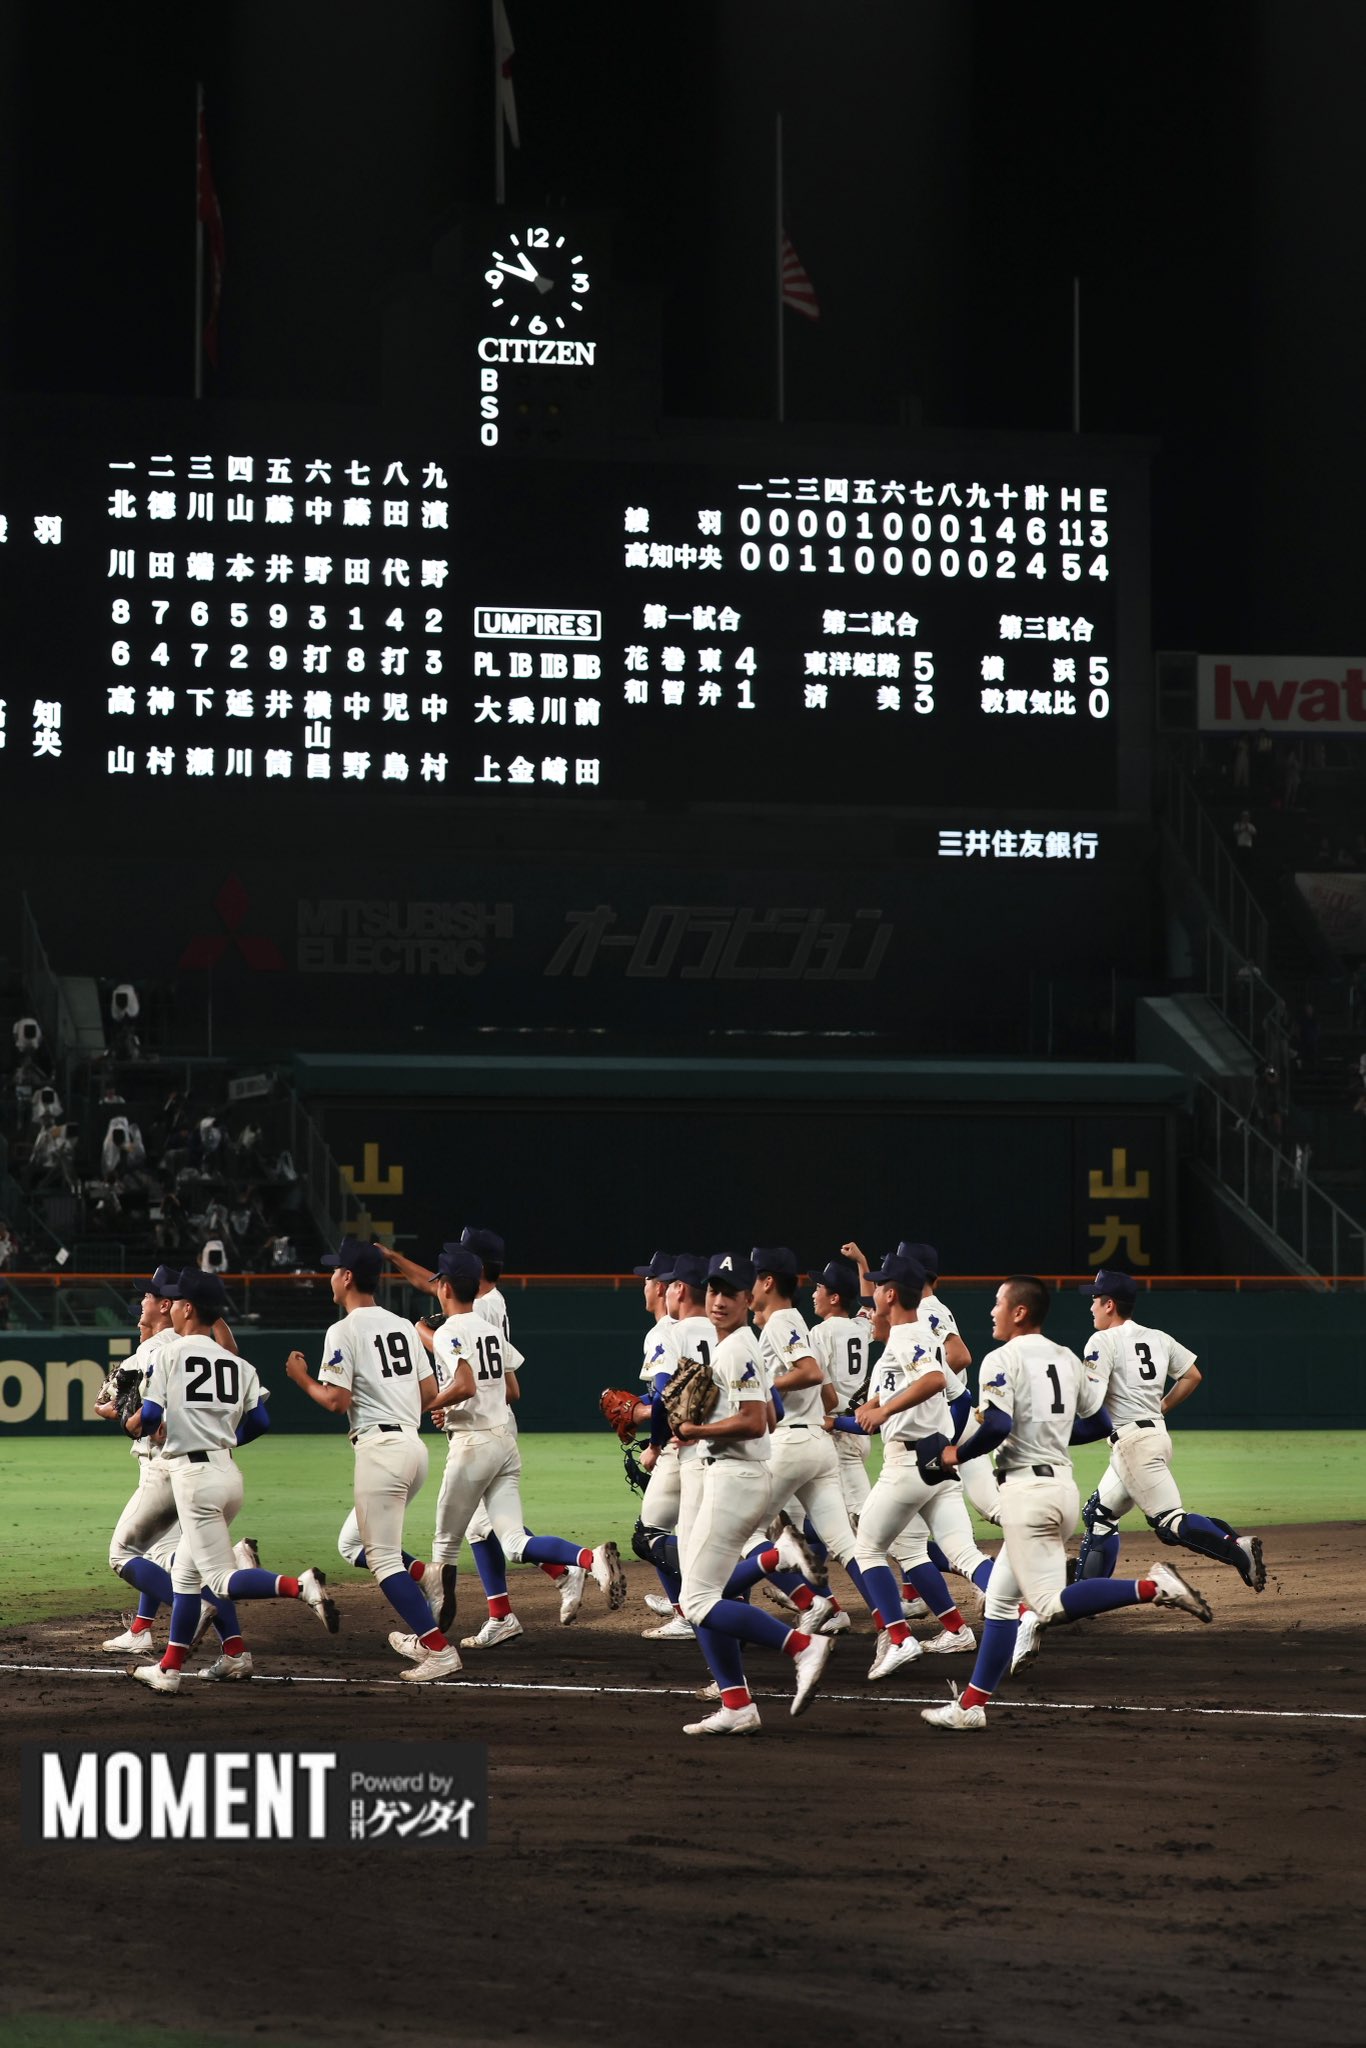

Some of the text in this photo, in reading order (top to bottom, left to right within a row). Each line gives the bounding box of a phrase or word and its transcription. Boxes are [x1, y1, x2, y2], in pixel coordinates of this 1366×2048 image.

[527, 228, 549, 248] 12
[485, 270, 504, 289] 9
[571, 273, 590, 293] 3
[528, 315, 548, 335] 6
[478, 338, 596, 365] CITIZEN
[149, 455, 175, 476] 二
[188, 455, 214, 479] 三
[228, 456, 253, 482] 四
[266, 458, 293, 483] 五
[305, 459, 331, 484] 六
[344, 460, 370, 485] 七
[383, 461, 409, 486] 八
[423, 462, 448, 488] 九
[767, 478, 791, 499] 二
[796, 478, 820, 500] 三
[825, 479, 848, 503] 四
[852, 480, 877, 504] 五
[881, 480, 905, 504] 六
[910, 481, 934, 506] 七
[938, 483, 962, 507] 八
[966, 483, 990, 508] 九
[994, 484, 1018, 510] 十
[1024, 485, 1049, 511] 計
[1061, 488, 1081, 511] H
[1090, 489, 1107, 512] E
[740, 507, 760, 536] 0
[769, 508, 789, 537] 0
[798, 509, 818, 538] 0
[826, 510, 846, 538] 0
[857, 512, 873, 539] 1
[883, 512, 903, 540] 0
[912, 513, 931, 541] 0
[940, 514, 959, 542] 0
[970, 516, 986, 543] 1
[996, 517, 1016, 544] 4
[1027, 517, 1046, 545] 6
[1060, 519, 1084, 546] 11
[1090, 520, 1108, 547] 3
[625, 542, 1109, 581] 高知中央 0 0 1 1 0 0 0 0 0 2 4 5 4
[112, 599, 442, 632] 8 7 6 5 9 3 1 4 2
[483, 613, 592, 636] UMPIRES
[643, 604, 741, 631] 第一試合
[823, 609, 919, 637] 第二試合
[999, 615, 1094, 642] 第三試合
[112, 641, 442, 675] 6 4 7 2 9 打 8 打 3
[474, 652, 501, 676] PL
[735, 647, 757, 675] 4
[804, 651, 934, 681] 東洋姫路 5
[1089, 657, 1109, 686] 5
[738, 680, 755, 708] 1
[914, 684, 934, 714] 3
[981, 688, 1109, 718] 敦賀気比 0
[1215, 665, 1366, 721] Iwat
[938, 830, 1098, 859] 三井住友銀行
[299, 900, 513, 938] MITSUBISHI
[299, 938, 486, 976] ELECTRIC
[1089, 1147, 1150, 1266] 山九
[719, 1256, 733, 1271] A
[374, 1332, 412, 1377] 19
[476, 1336, 501, 1380] 16
[847, 1338, 861, 1375] 6
[1135, 1343, 1156, 1380] 3
[185, 1356, 239, 1404] 20
[883, 1372, 896, 1391] A
[1046, 1364, 1064, 1413] 1
